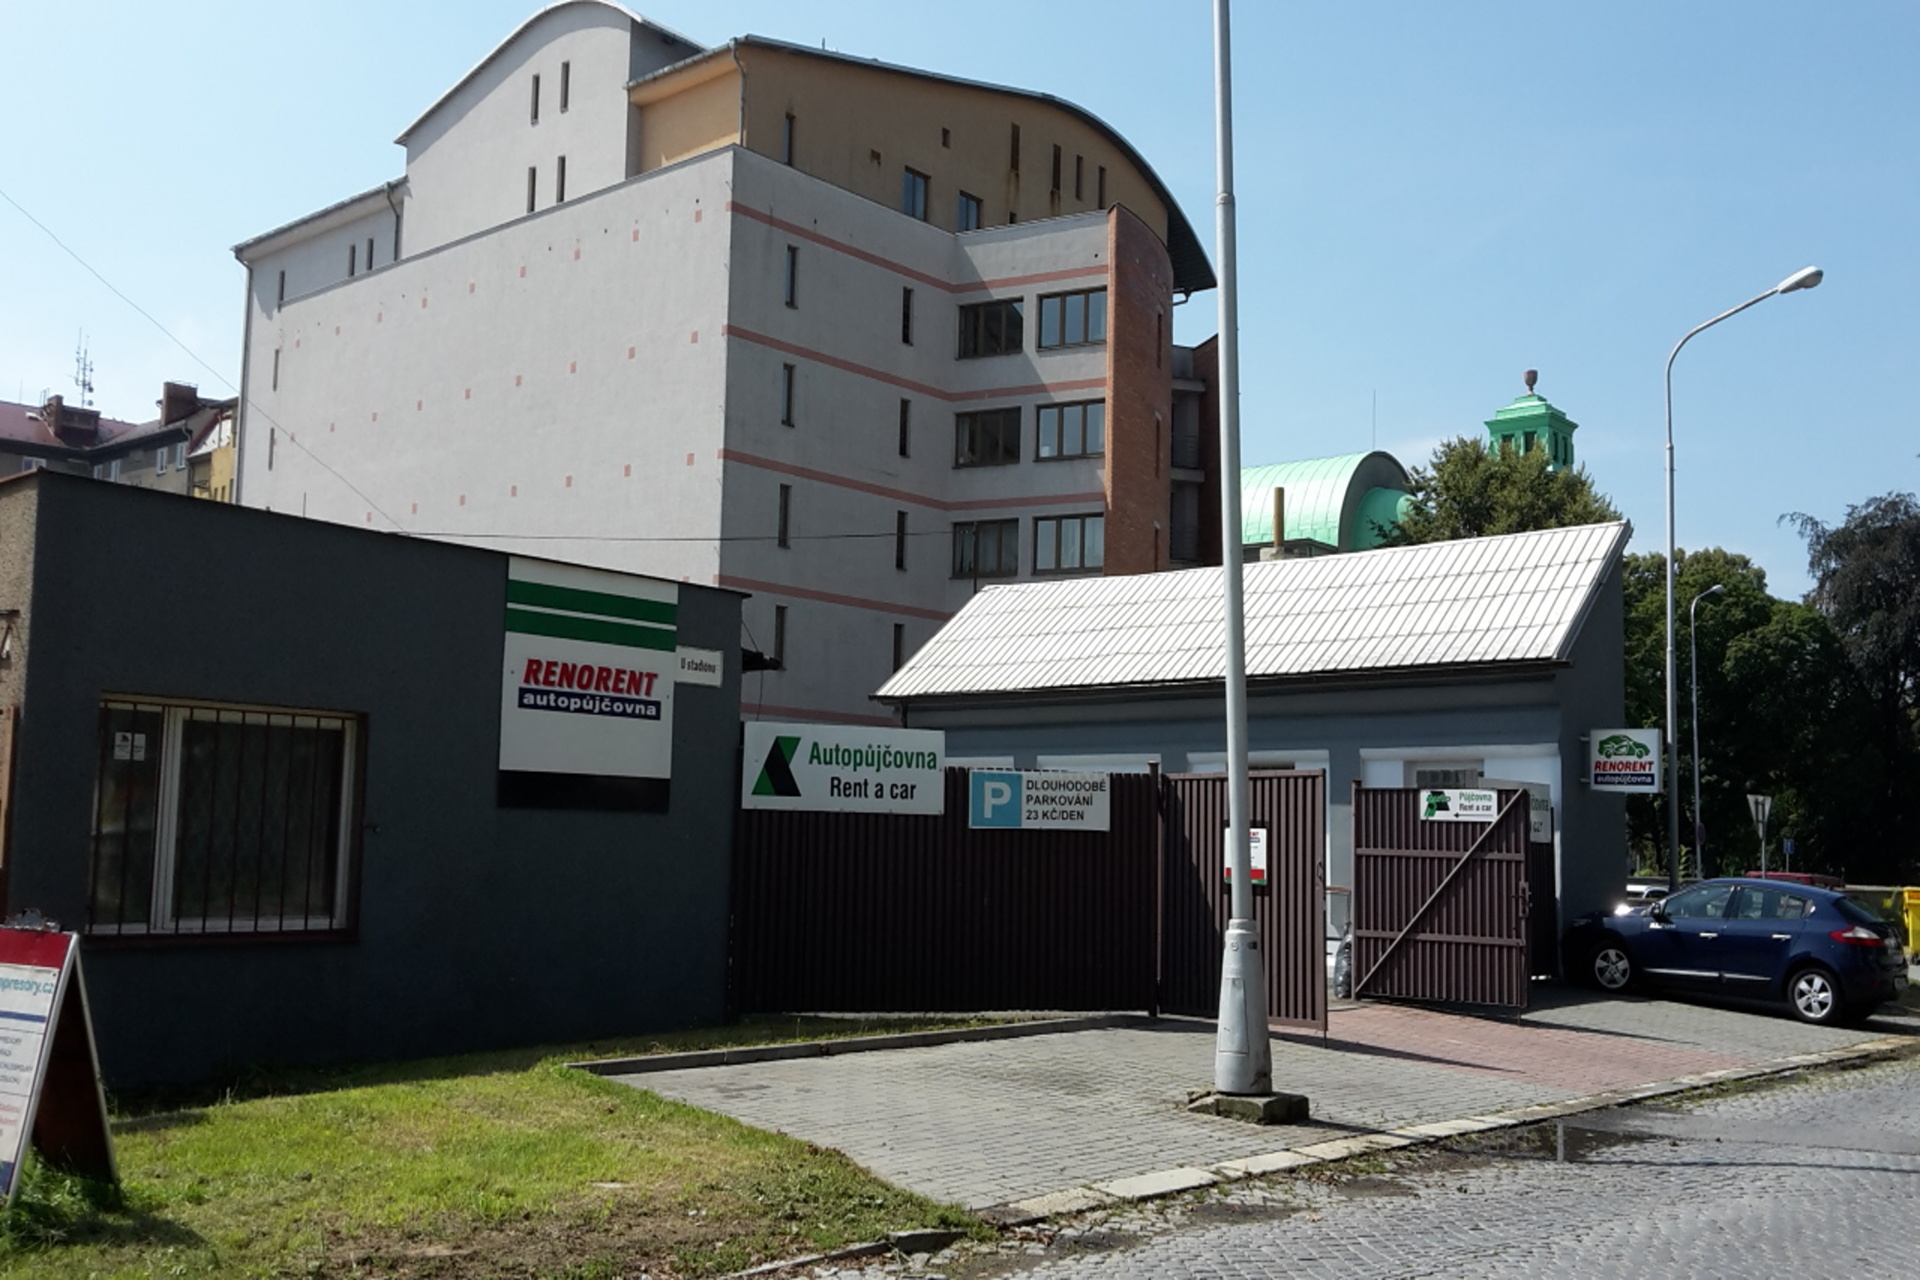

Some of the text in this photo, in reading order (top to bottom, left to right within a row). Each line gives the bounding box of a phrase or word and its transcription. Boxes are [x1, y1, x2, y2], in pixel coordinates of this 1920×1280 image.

[680, 657, 687, 670] U
[523, 658, 658, 697] RENORENT
[522, 690, 657, 717] autopůjčovna
[808, 741, 938, 773] Autopůjčovna
[1594, 760, 1655, 772] RENORENT
[830, 776, 917, 801] Rent a car
[1026, 779, 1107, 792] DLOUHODOBÉ
[983, 781, 1013, 819] P
[1026, 793, 1093, 806] PARKOVÁNÍ
[1459, 803, 1474, 811] Rent
[1026, 808, 1085, 821] 23 KČ/DEN
